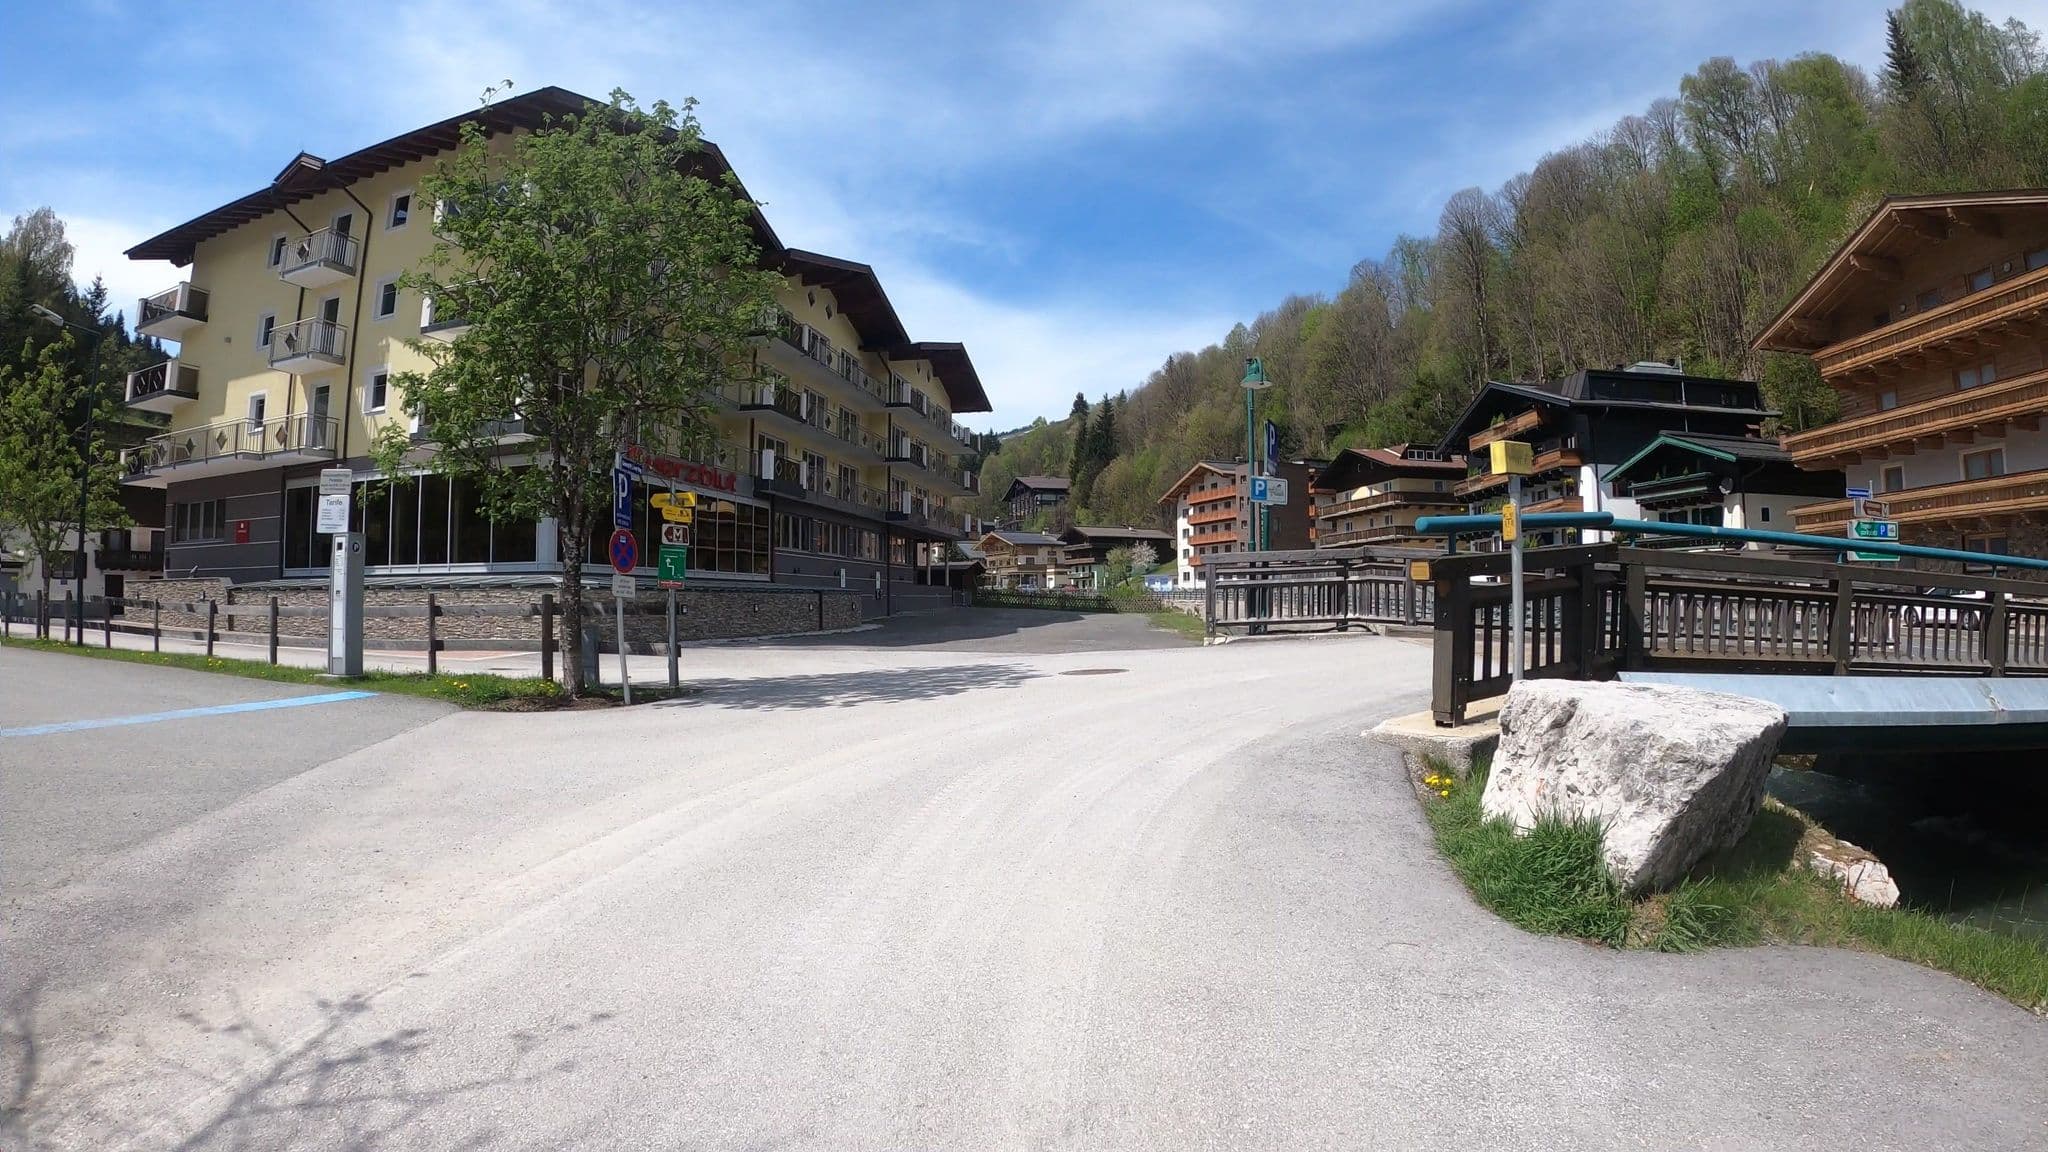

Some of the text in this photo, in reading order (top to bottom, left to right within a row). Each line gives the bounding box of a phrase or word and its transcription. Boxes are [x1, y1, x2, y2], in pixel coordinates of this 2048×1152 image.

[1269, 423, 1276, 455] P
[618, 473, 628, 509] P
[1255, 480, 1265, 495] P
[673, 528, 683, 542] M
[1880, 525, 1886, 536] P
